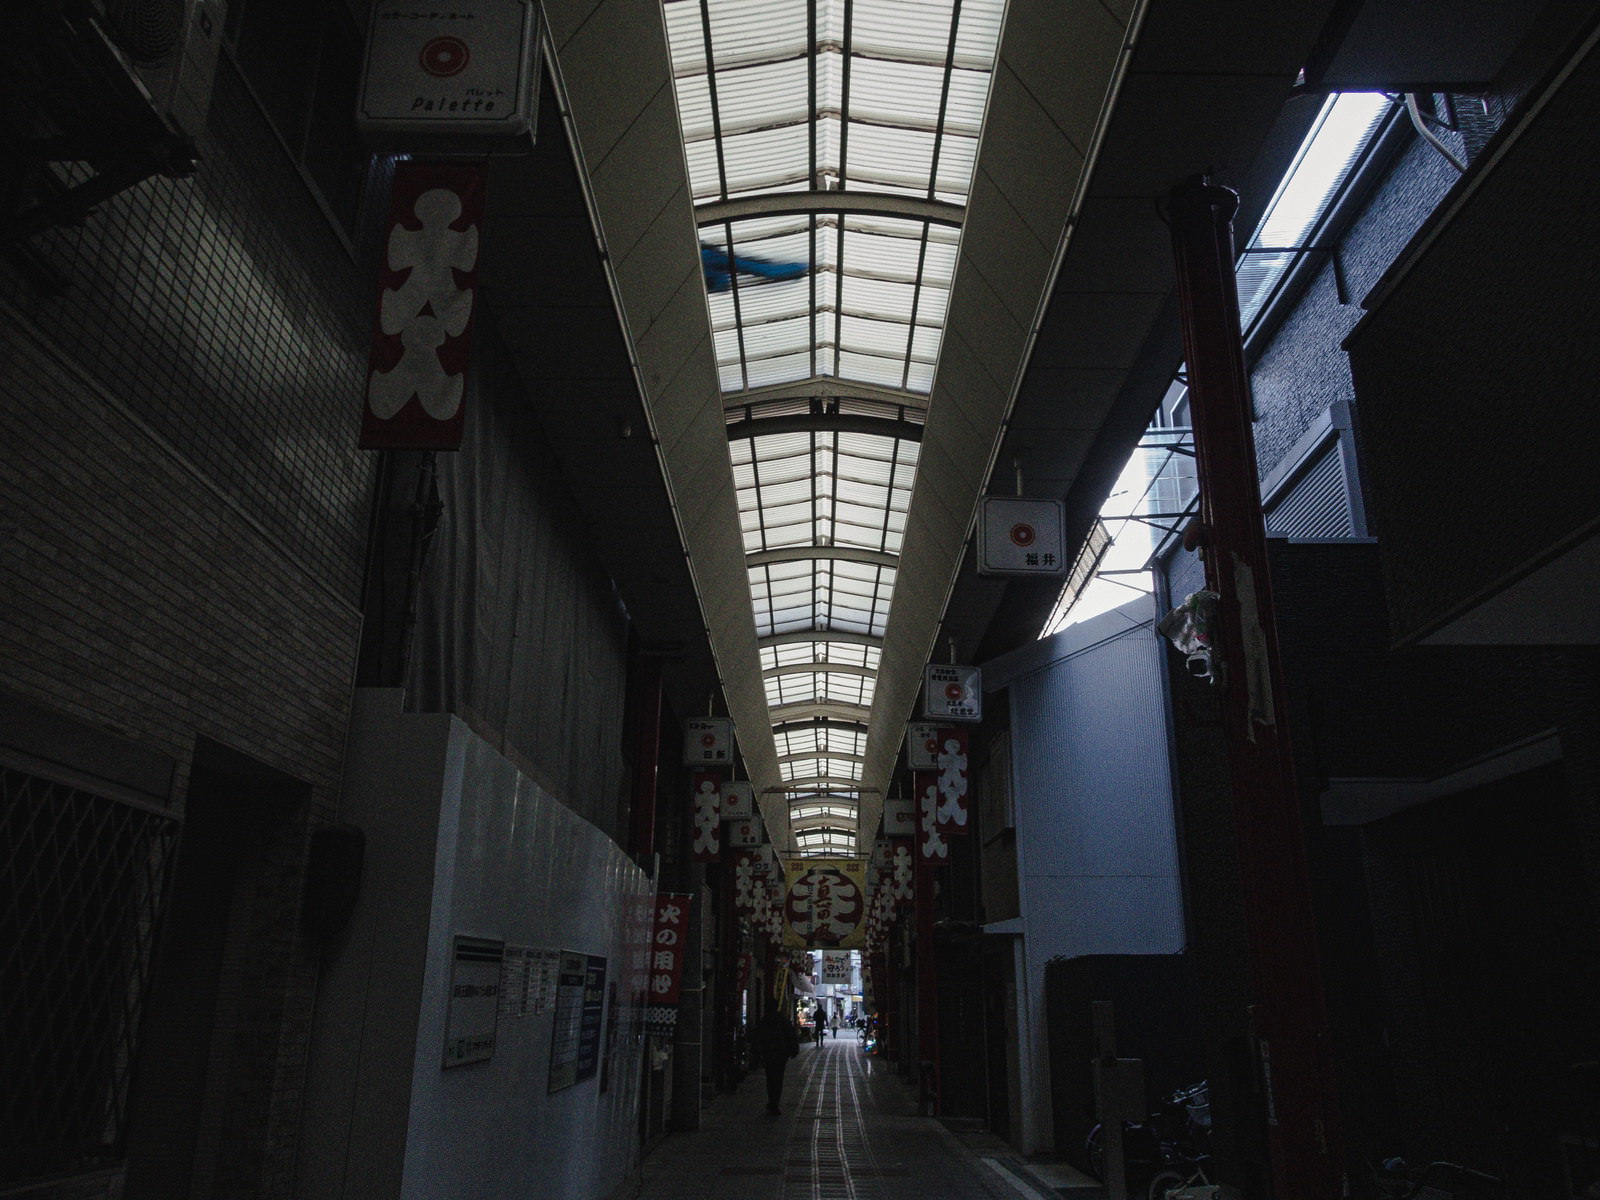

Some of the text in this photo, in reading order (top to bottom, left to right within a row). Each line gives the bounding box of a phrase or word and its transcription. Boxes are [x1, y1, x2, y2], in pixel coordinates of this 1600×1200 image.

[466, 88, 504, 96] パレット
[411, 97, 496, 111] Palette
[1025, 552, 1056, 566] 福井
[651, 904, 681, 995] 火の用心
